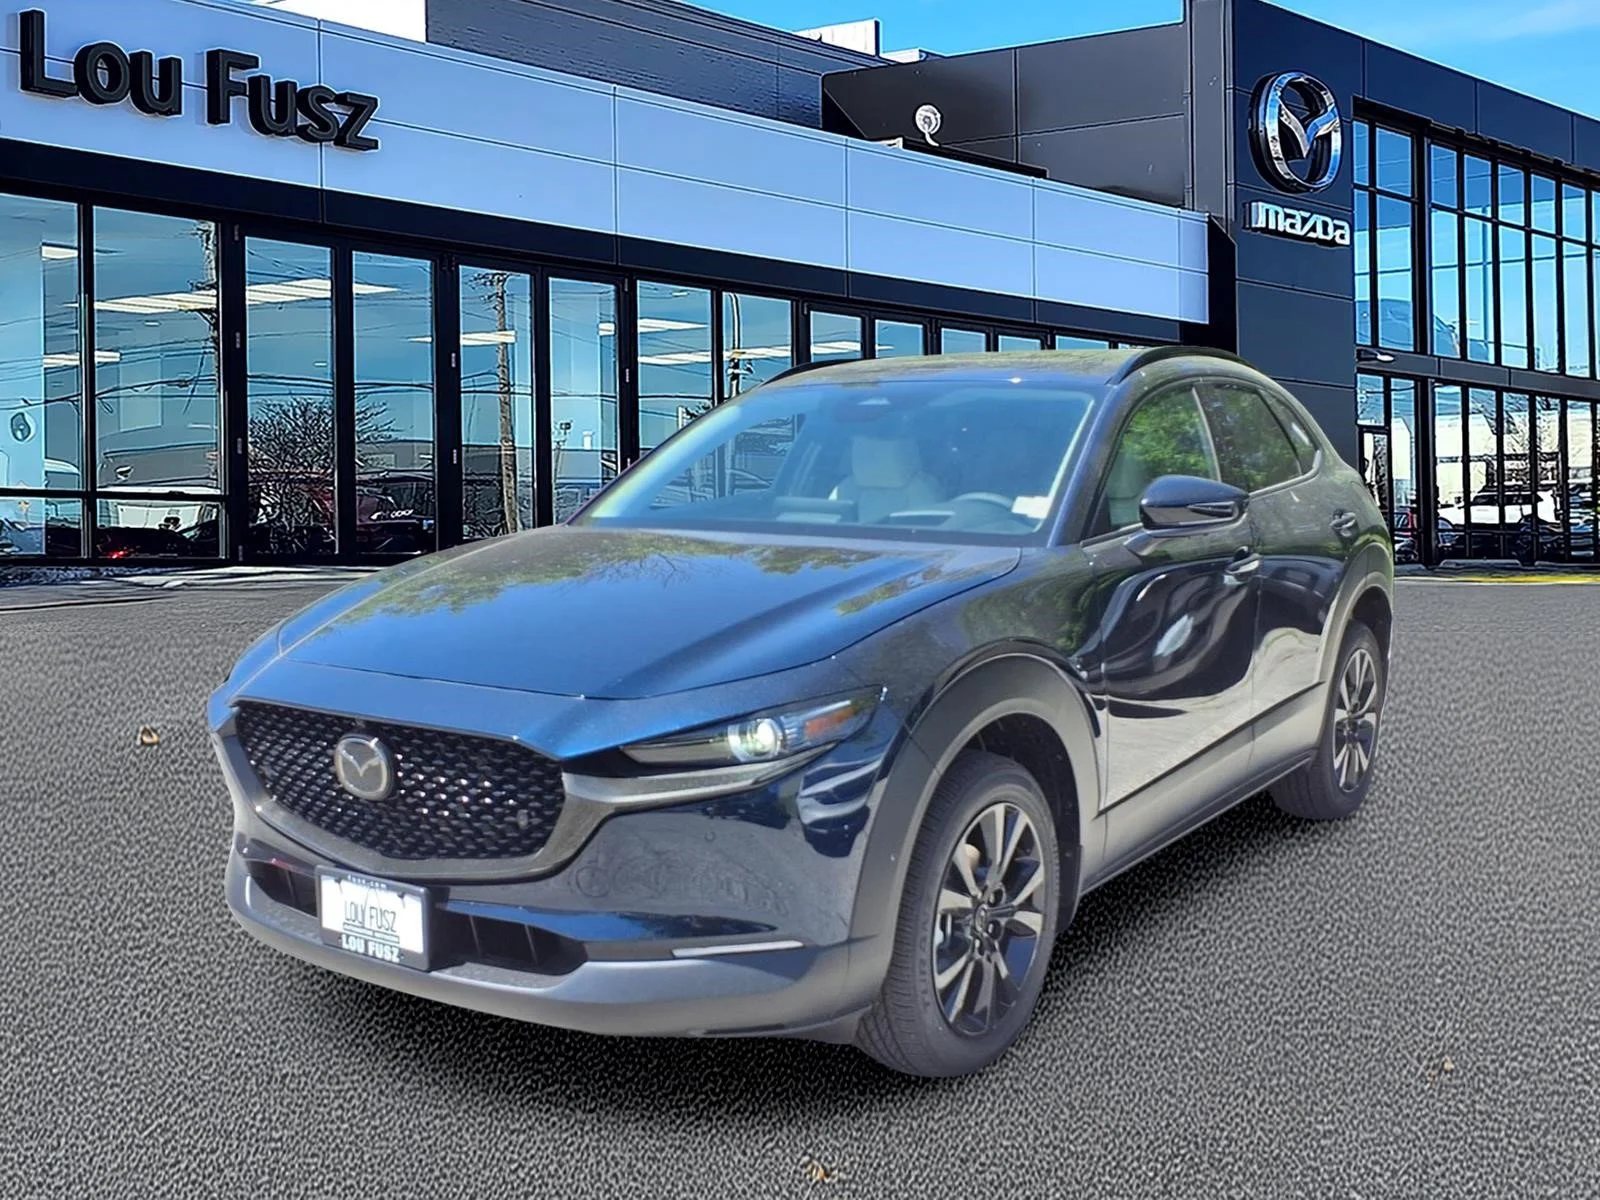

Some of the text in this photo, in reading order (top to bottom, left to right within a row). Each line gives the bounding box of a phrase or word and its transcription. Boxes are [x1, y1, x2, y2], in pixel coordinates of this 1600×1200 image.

[20, 9, 380, 151] Lou Fusz
[369, 906, 397, 932] FUSZ
[342, 934, 400, 963] LOU FUSZ
